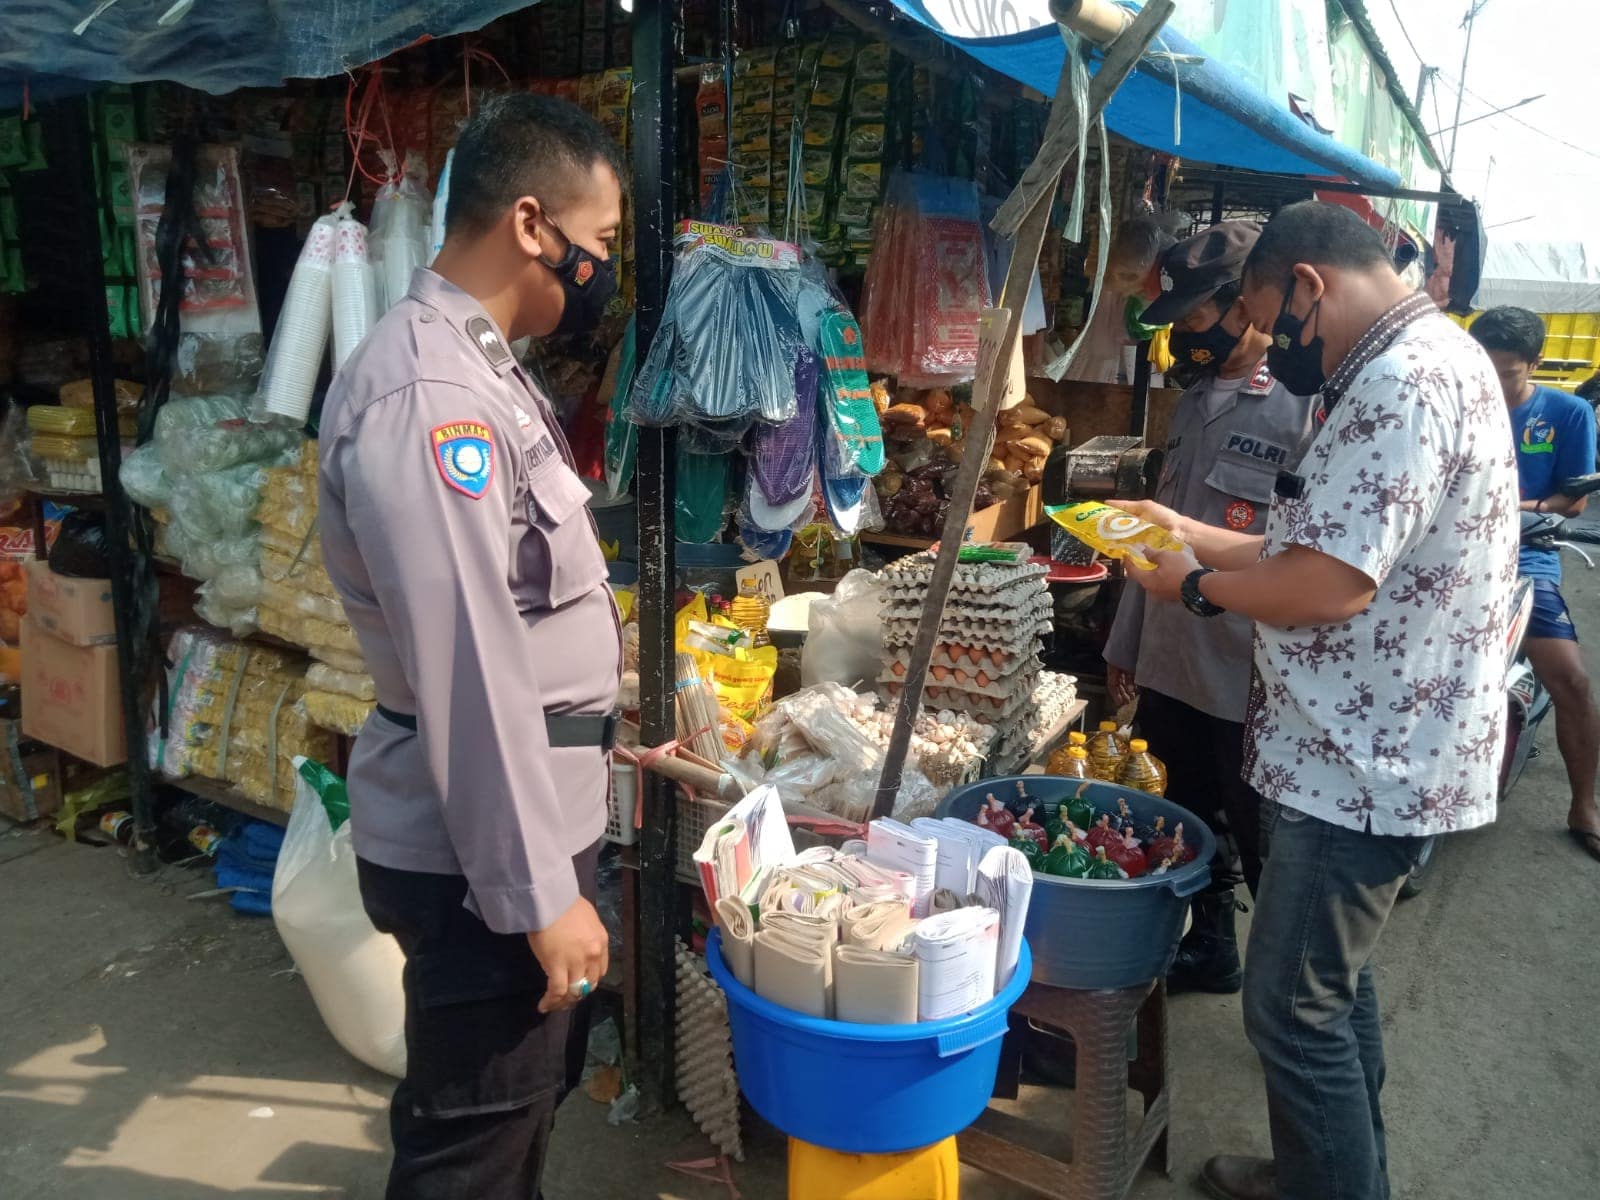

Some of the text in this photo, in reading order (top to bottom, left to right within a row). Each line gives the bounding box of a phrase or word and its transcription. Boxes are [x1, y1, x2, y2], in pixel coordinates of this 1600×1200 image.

[704, 234, 774, 258] SWALLOW
[441, 423, 486, 439] BINMAS
[1228, 435, 1287, 464] POLRI
